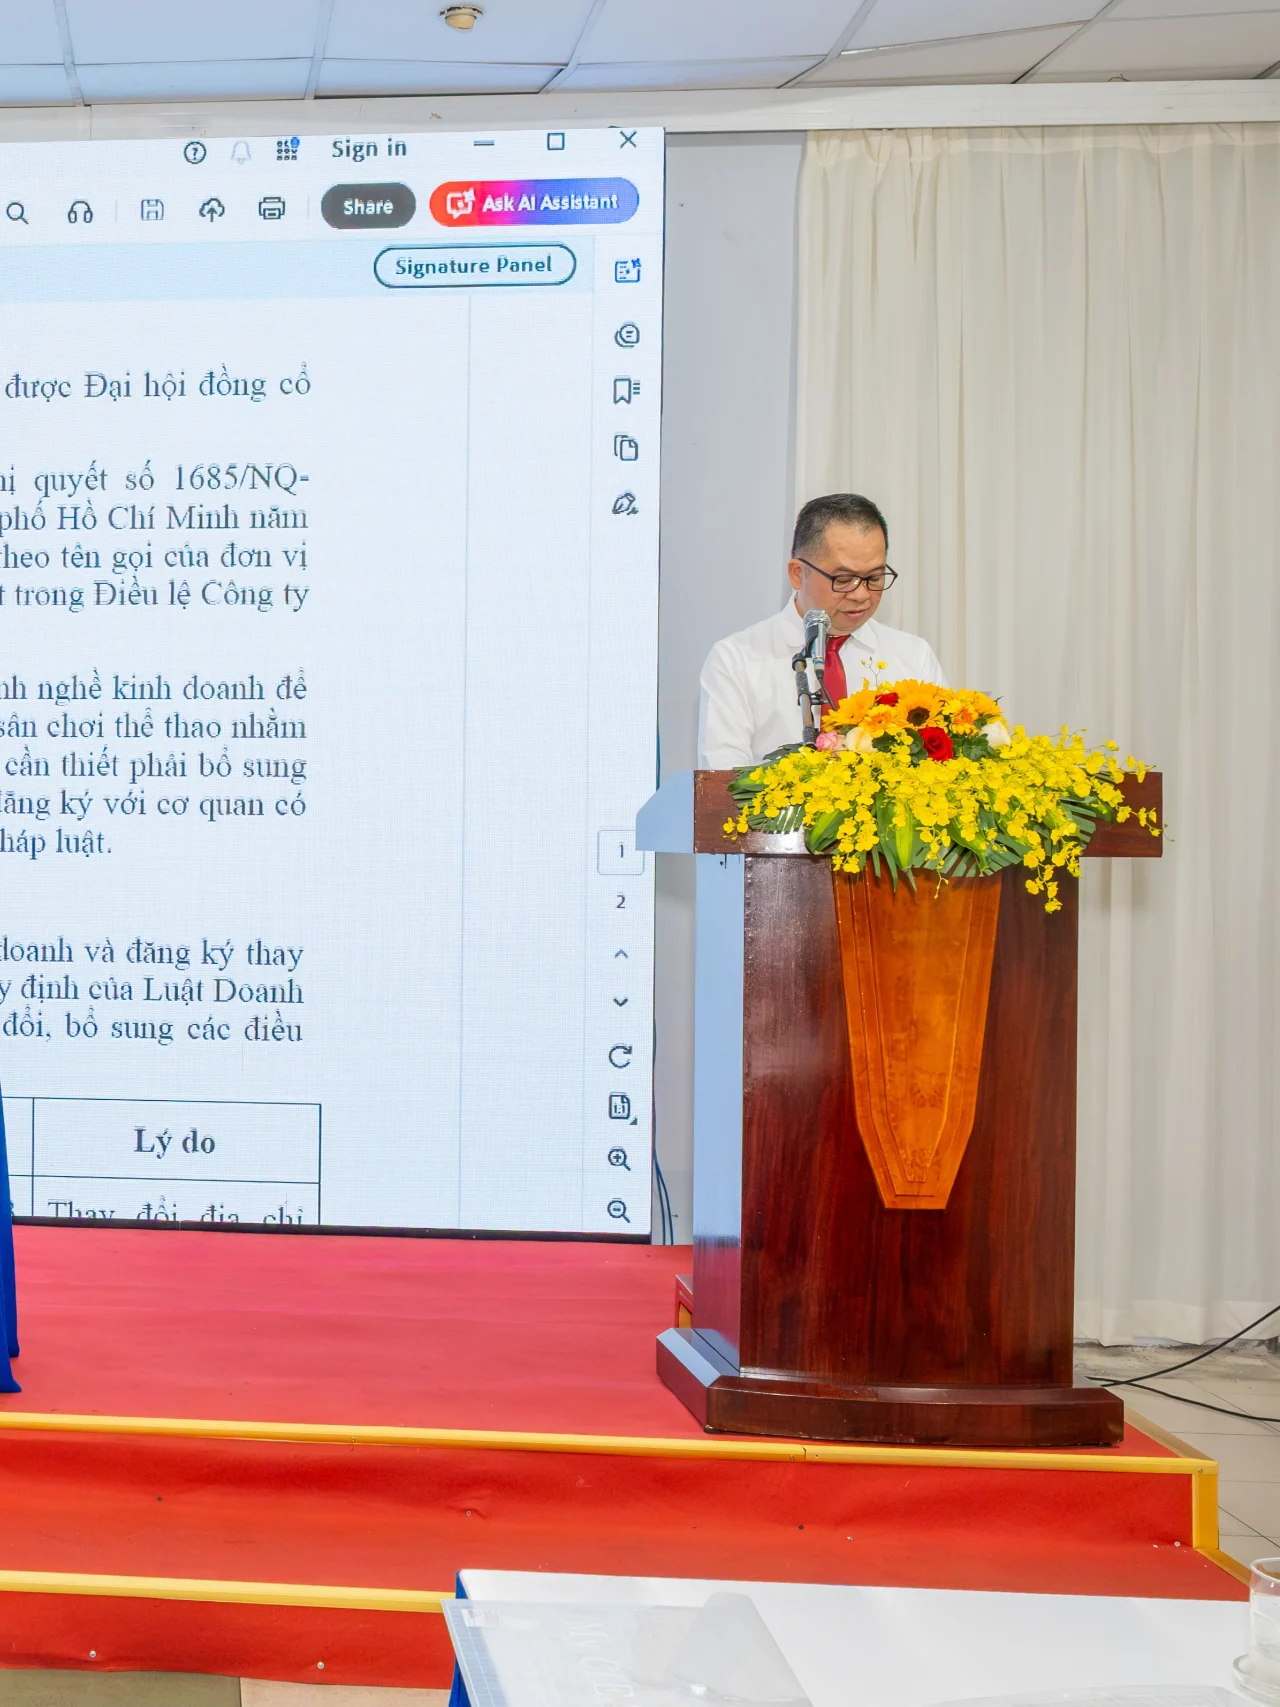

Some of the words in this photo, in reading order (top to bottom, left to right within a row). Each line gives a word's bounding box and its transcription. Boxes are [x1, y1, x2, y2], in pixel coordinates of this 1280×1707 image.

[331, 138, 378, 163] Sign
[387, 135, 407, 157] in
[343, 198, 394, 216] Share
[482, 195, 515, 213] Ask
[518, 194, 536, 212] AI
[540, 193, 619, 211] Assistant
[395, 255, 490, 280] Signature
[497, 252, 553, 274] Panel
[4, 372, 72, 403] được
[84, 371, 132, 403] Đại
[143, 370, 186, 402] hội
[198, 363, 267, 403] đồng
[33, 459, 109, 502] quyết
[124, 458, 155, 491] số
[175, 462, 310, 497] 1685/NQ-
[37, 666, 103, 706] nghề
[112, 674, 173, 701] kinh
[182, 674, 266, 701] doanh
[275, 669, 308, 701] để
[615, 892, 627, 909] 2
[83, 936, 116, 965] và
[125, 936, 192, 972] đăng
[200, 937, 236, 972] ký
[245, 937, 305, 973] thay
[20, 973, 81, 1002] định
[142, 976, 205, 1007] Luật
[213, 976, 305, 1005] Doanh
[110, 1020, 175, 1047] sung
[187, 1015, 231, 1041] các
[243, 1009, 303, 1043] điều
[133, 1127, 173, 1160] Lý
[181, 1127, 216, 1155] do
